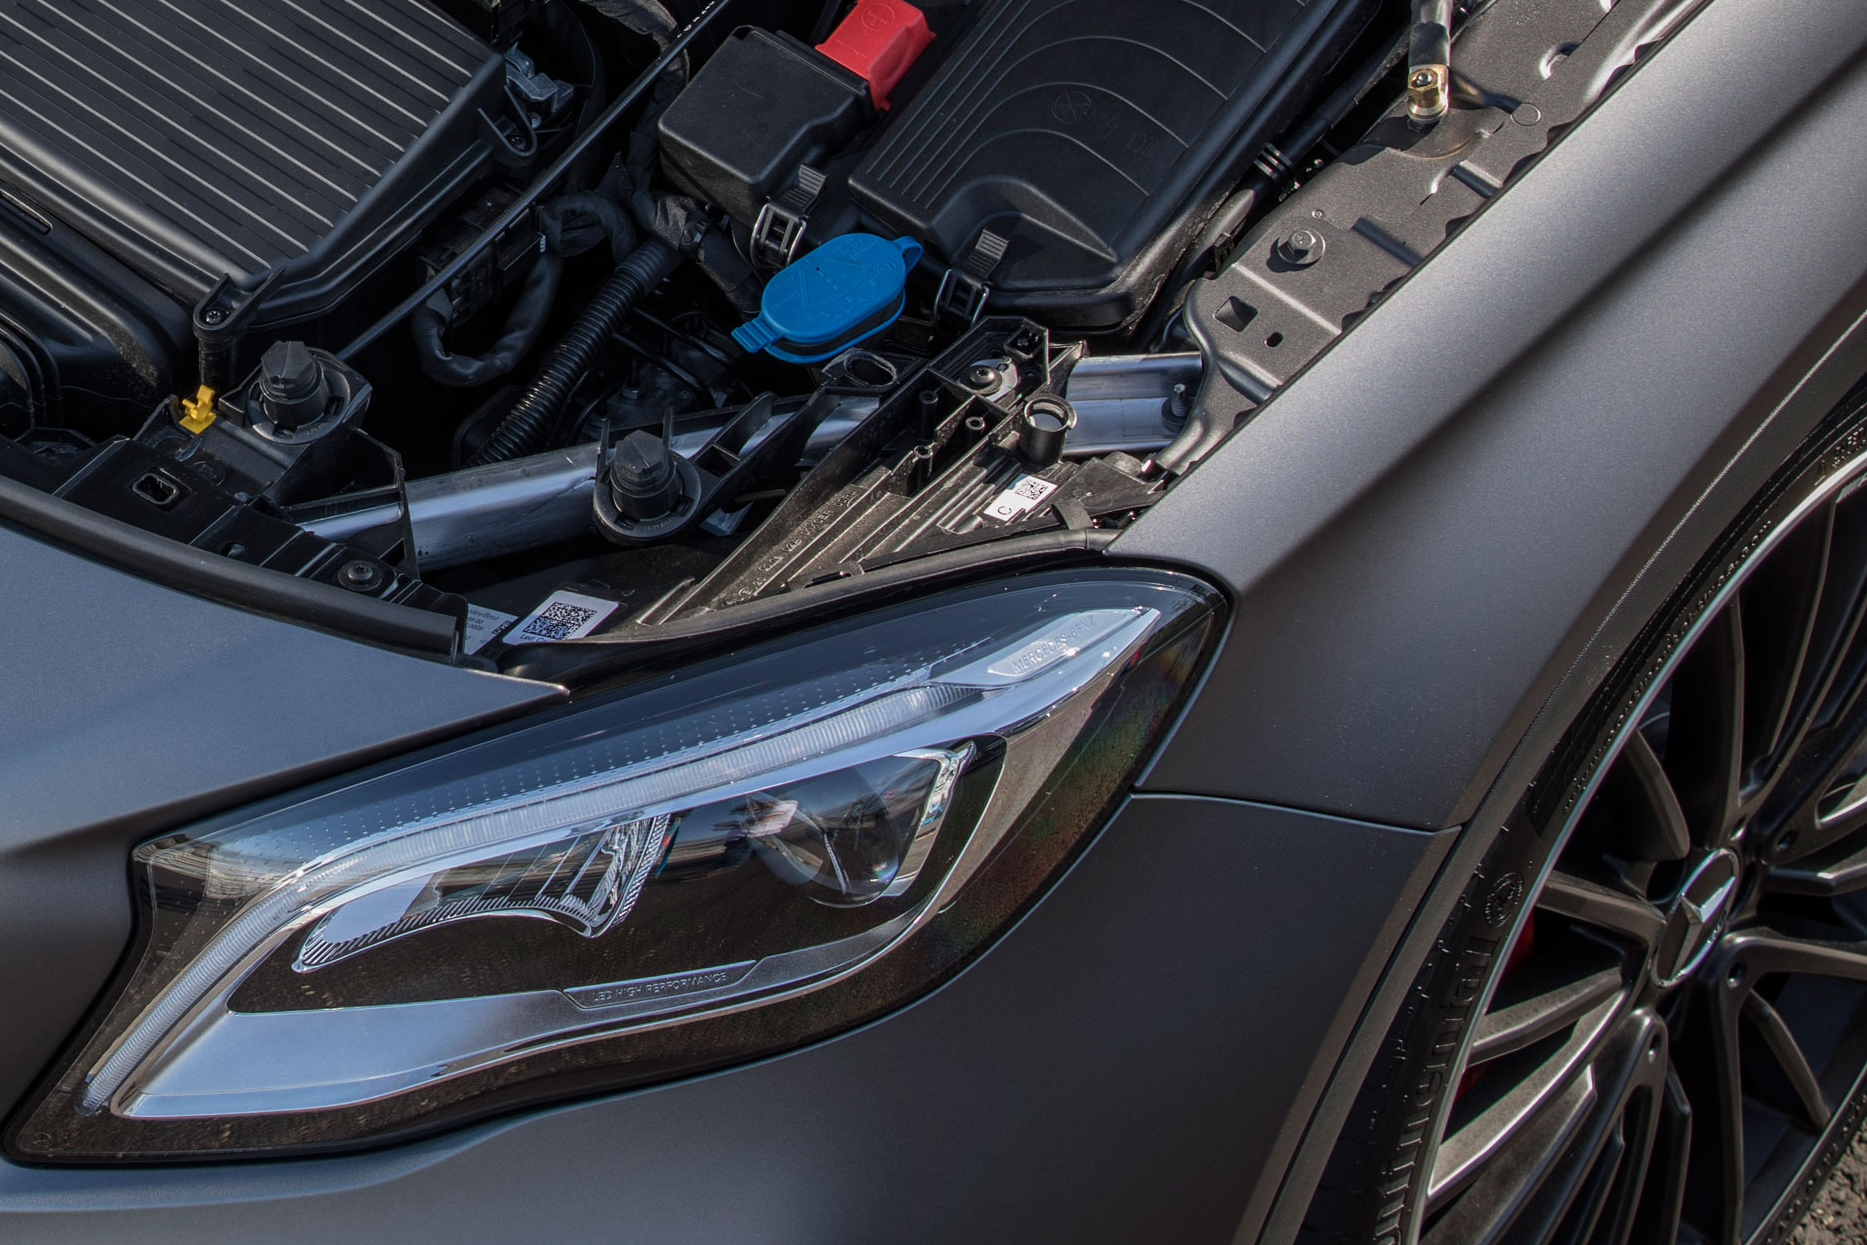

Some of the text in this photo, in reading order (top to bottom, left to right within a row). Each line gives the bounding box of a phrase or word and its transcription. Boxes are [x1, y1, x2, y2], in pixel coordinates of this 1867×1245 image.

[1012, 615, 1096, 674] MERCEDES-BENZ
[593, 971, 727, 1002] LED HIGH PERFORMANCE
